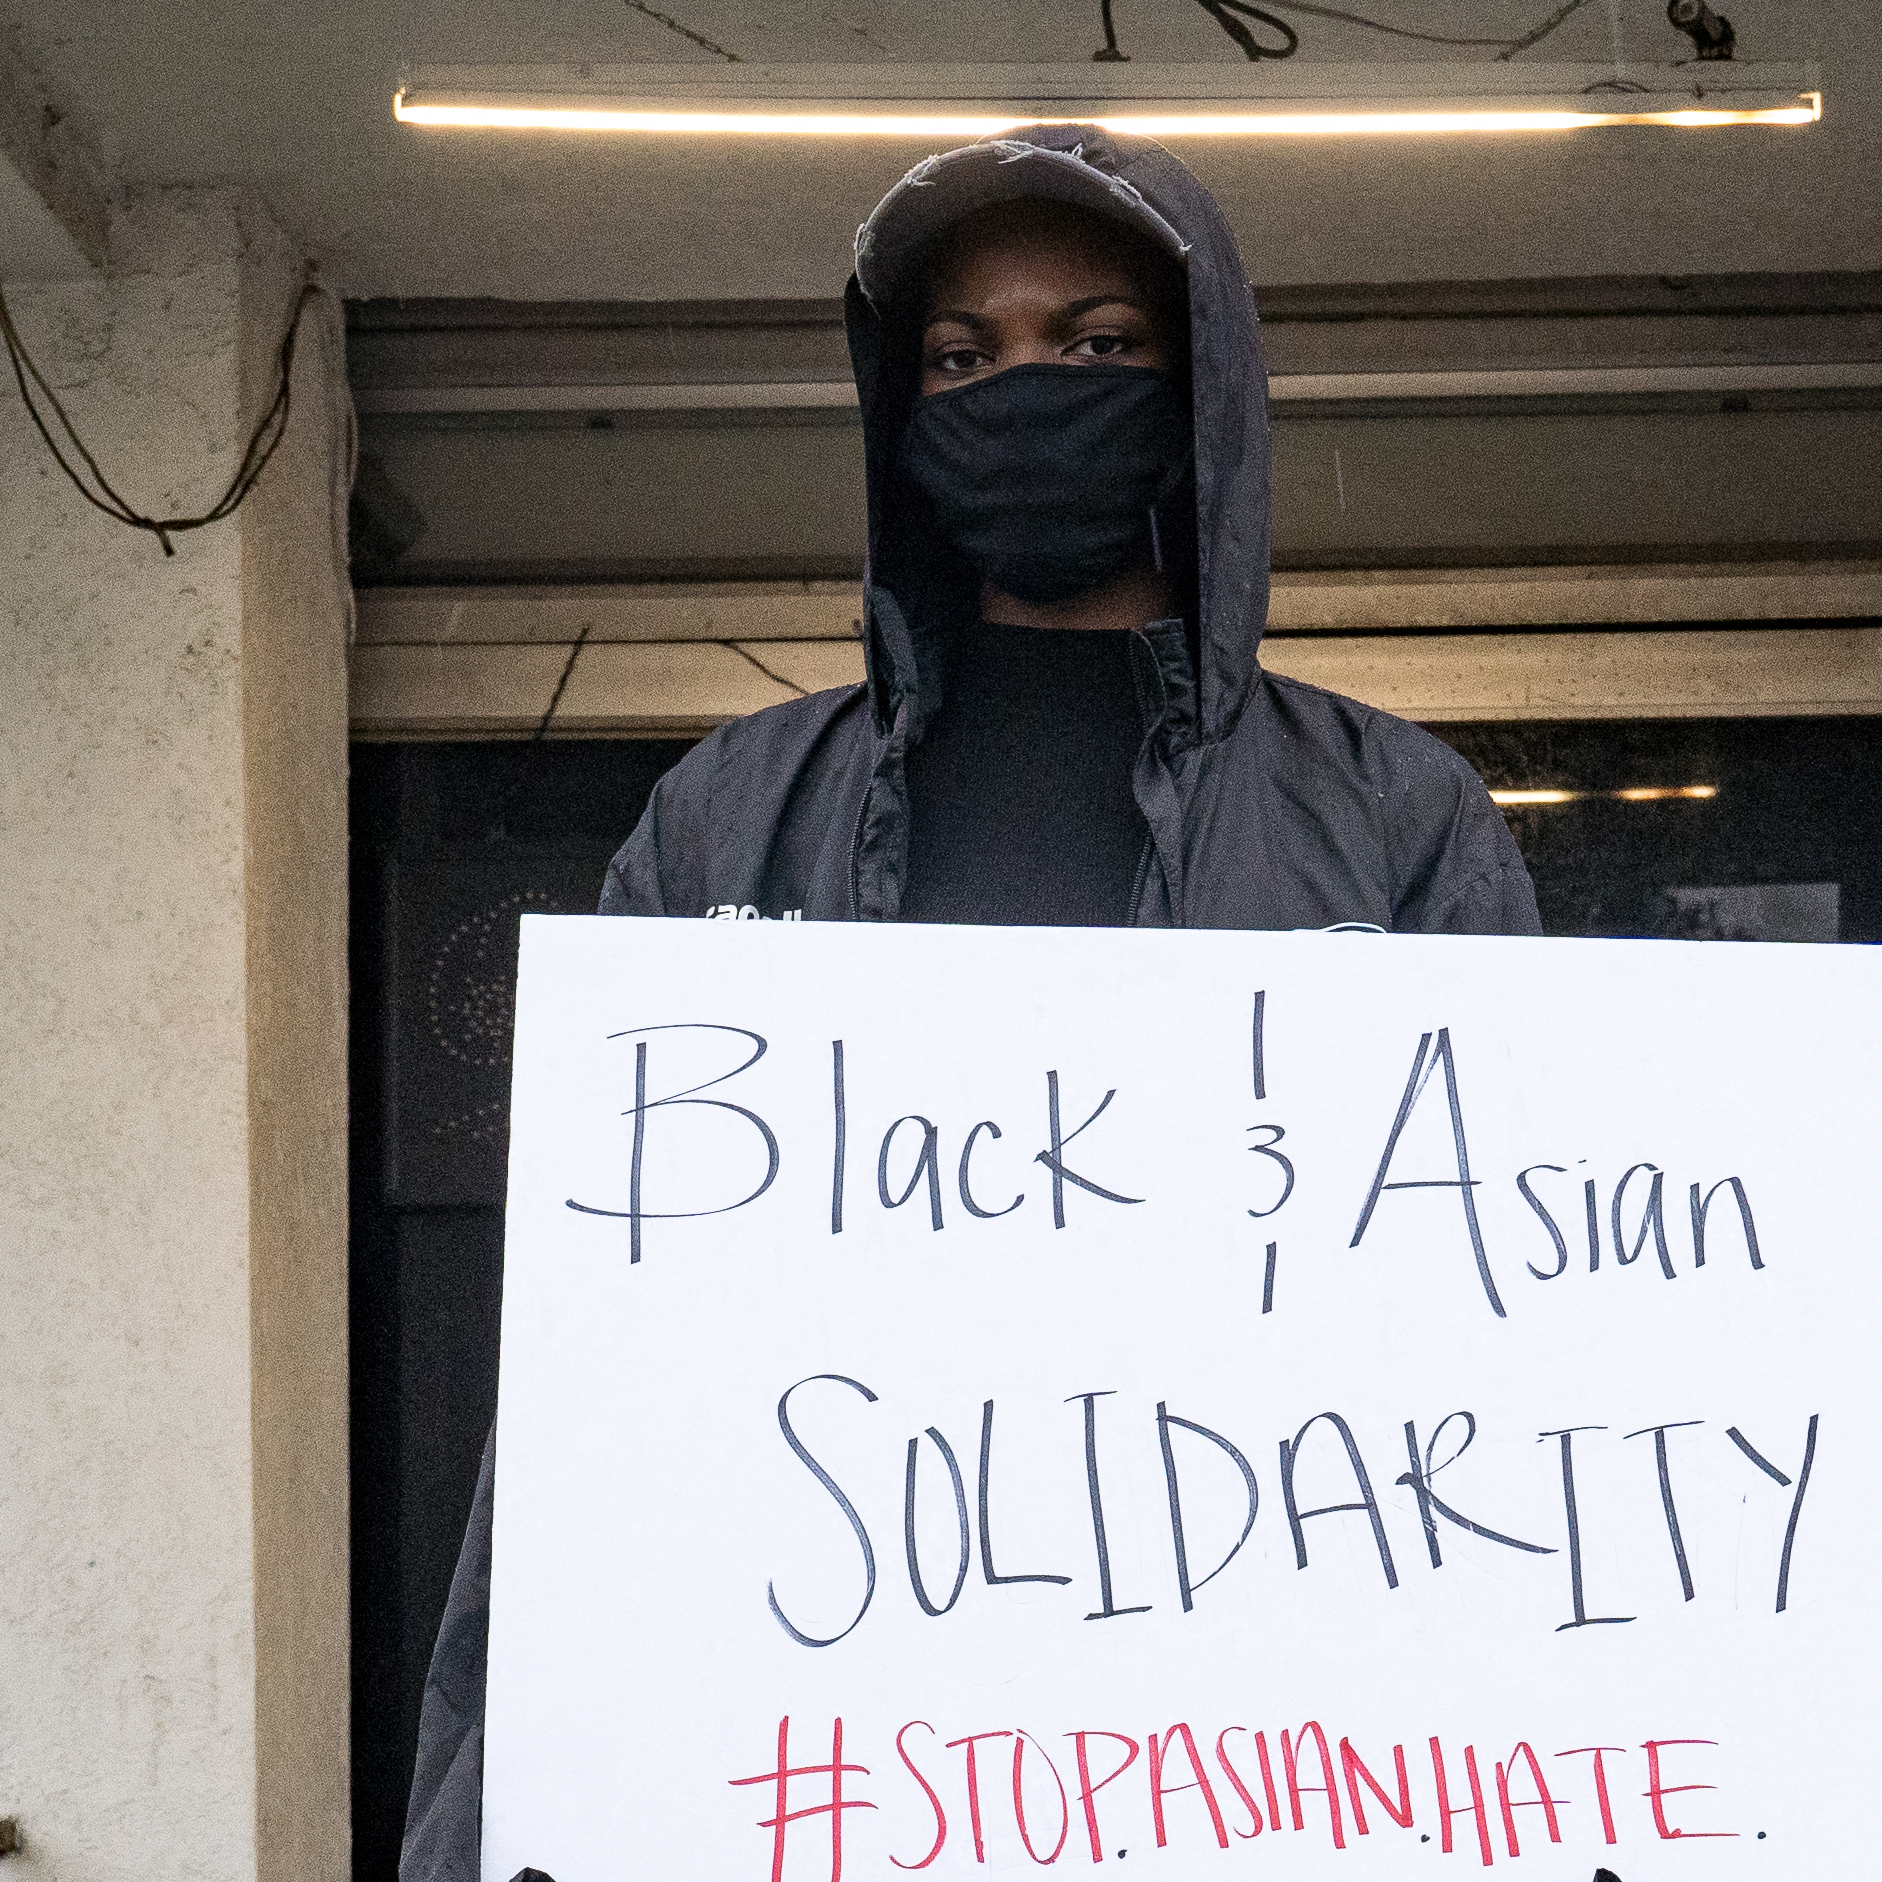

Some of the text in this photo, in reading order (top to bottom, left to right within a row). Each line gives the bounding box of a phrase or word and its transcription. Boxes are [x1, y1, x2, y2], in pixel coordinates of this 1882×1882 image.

[566, 1025, 1143, 1264] Black
[1350, 1027, 1766, 1318] Asian
[768, 1374, 1820, 1648] SOLIDARITY
